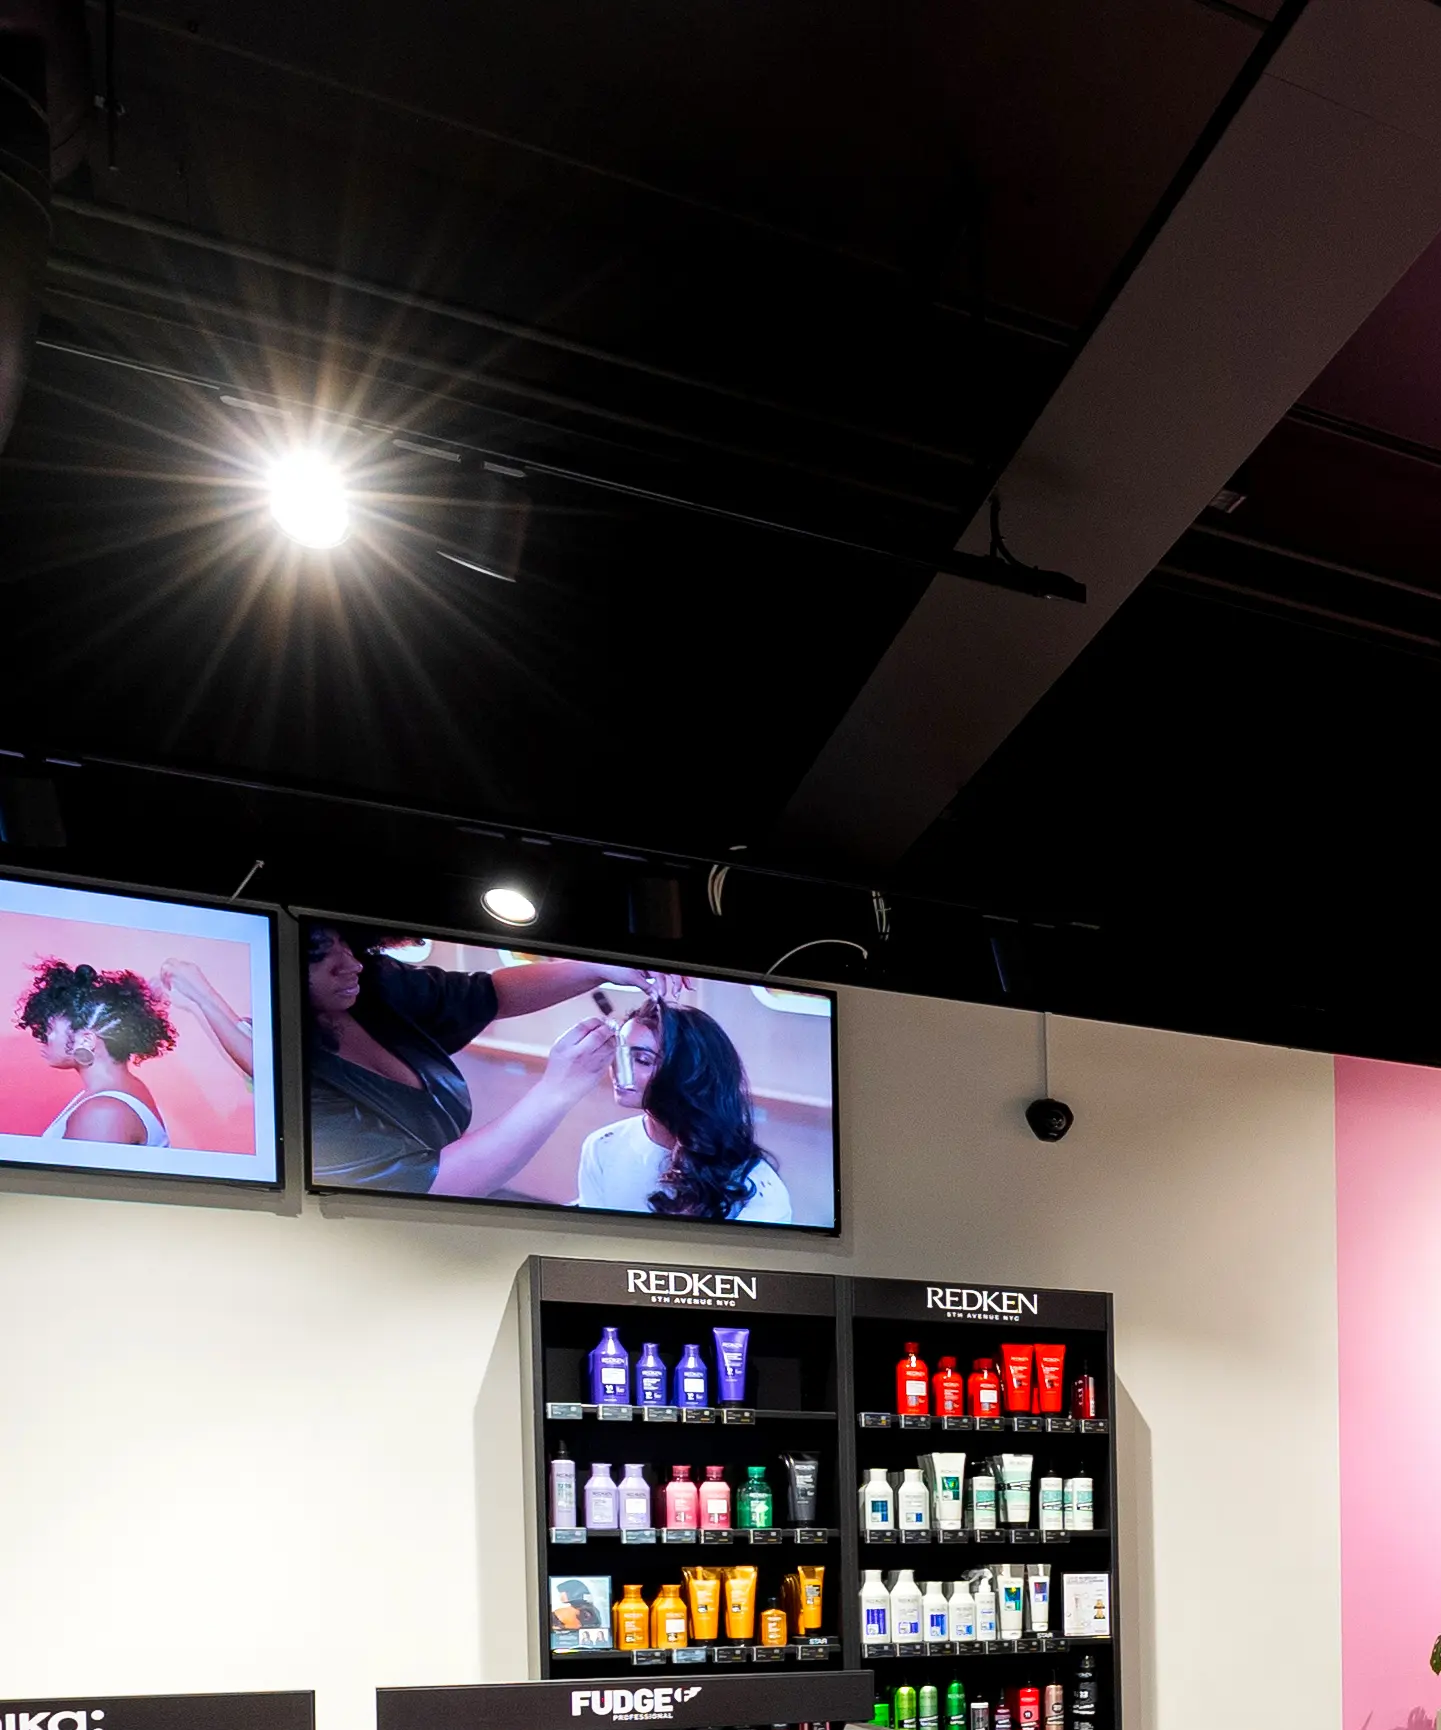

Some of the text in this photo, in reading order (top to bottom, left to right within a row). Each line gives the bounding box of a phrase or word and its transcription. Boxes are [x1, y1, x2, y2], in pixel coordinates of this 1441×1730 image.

[626, 1269, 757, 1299] REDKEN
[674, 1297, 712, 1306] AVENUE
[926, 1286, 1038, 1315] REDKEN
[967, 1313, 999, 1321] AVENUE
[571, 1687, 674, 1717] FUDGE
[613, 1712, 673, 1721] PROFESSIONAL
